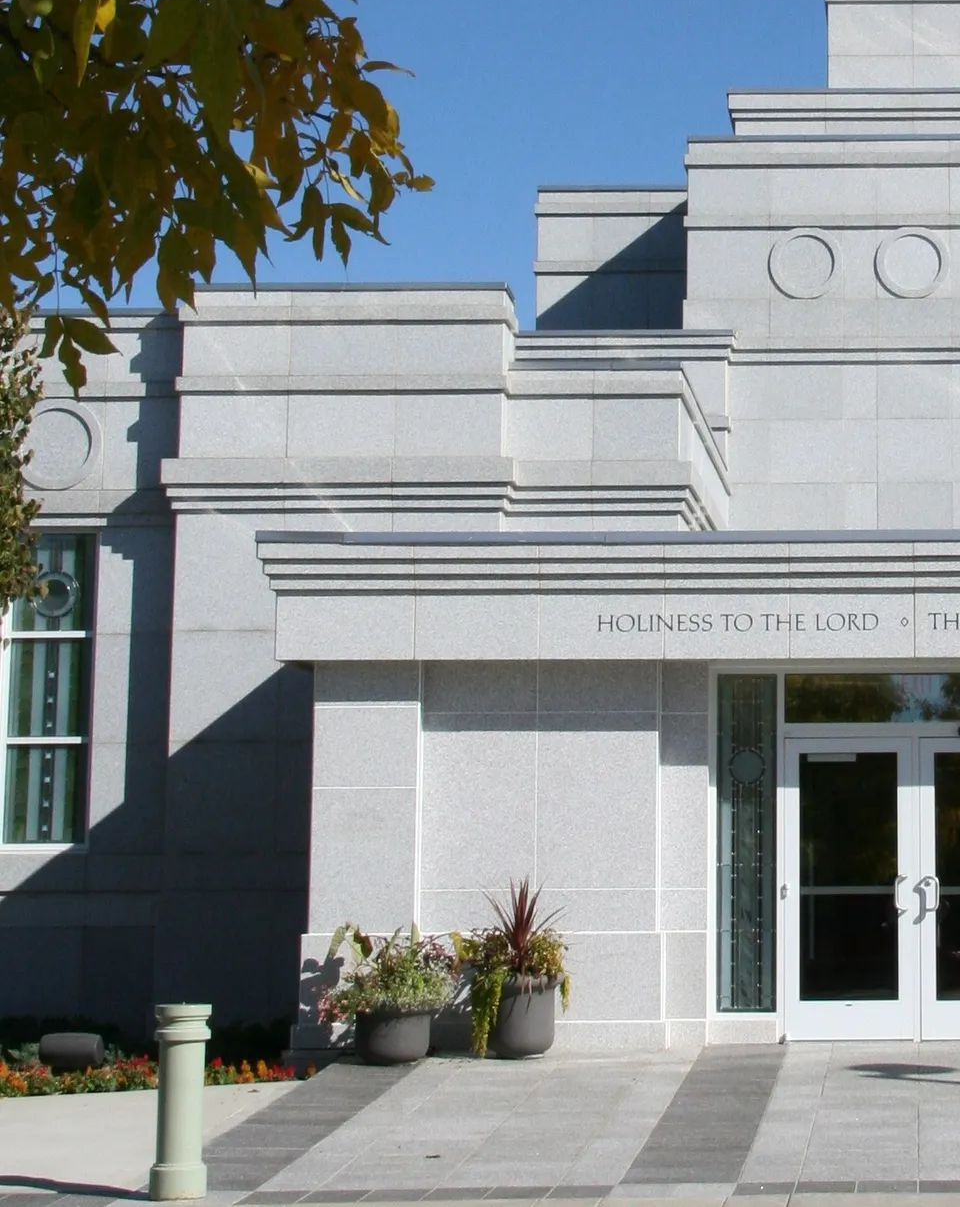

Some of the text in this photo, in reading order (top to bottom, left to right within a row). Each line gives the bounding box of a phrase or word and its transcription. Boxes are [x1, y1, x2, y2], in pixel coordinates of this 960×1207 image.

[597, 613, 713, 633] HOLINESS
[720, 613, 753, 633] TO
[760, 613, 806, 632] THE
[815, 612, 879, 632] LORD
